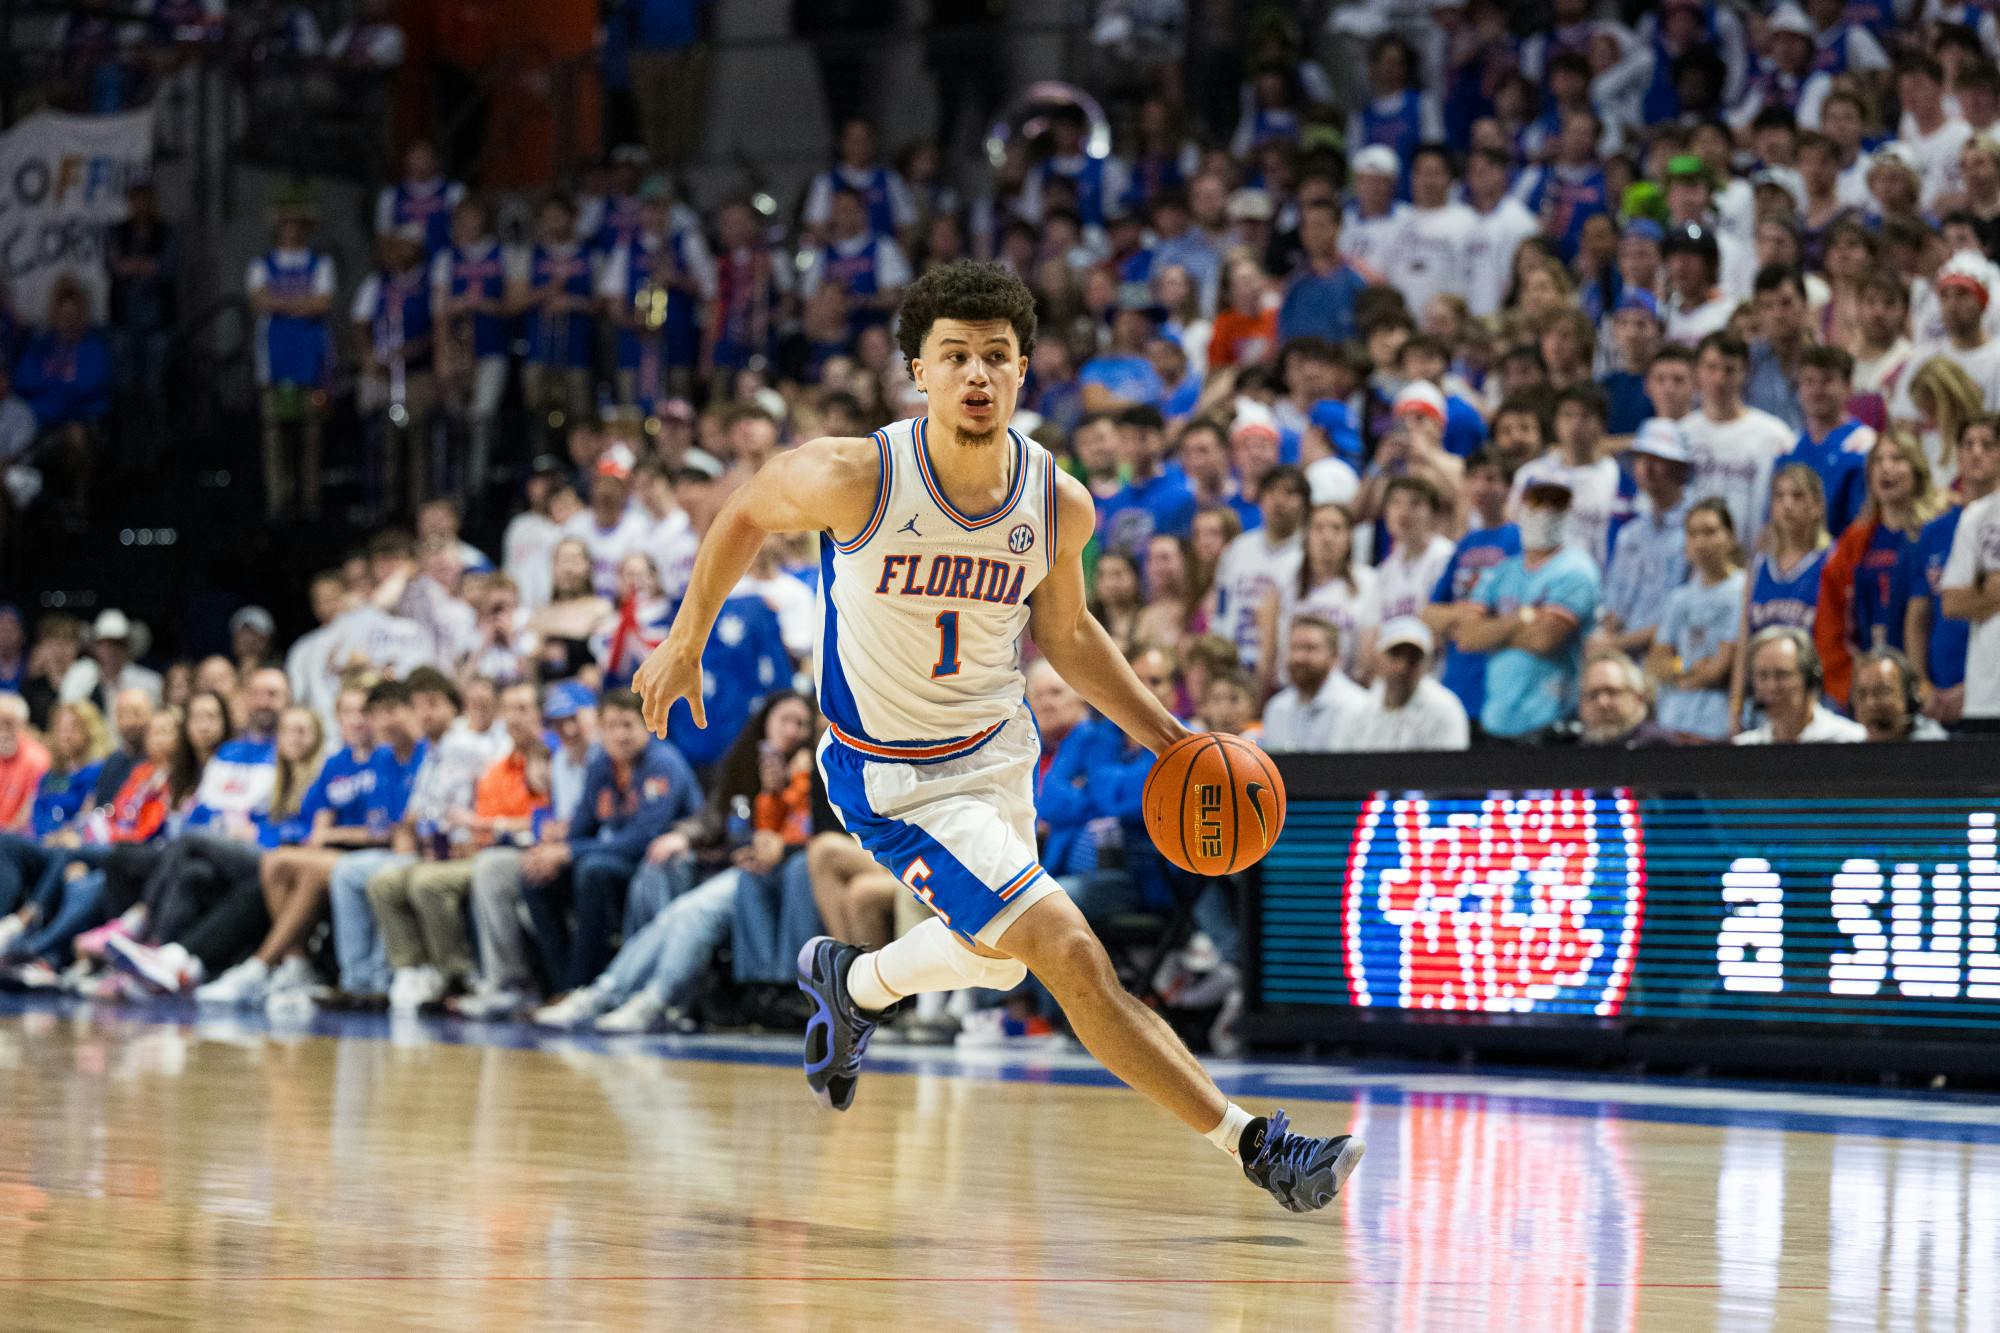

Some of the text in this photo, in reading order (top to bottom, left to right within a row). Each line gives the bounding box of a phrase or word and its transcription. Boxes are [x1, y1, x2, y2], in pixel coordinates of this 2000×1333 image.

[1009, 525, 1033, 553] SEC
[875, 555, 1025, 605] FLORIDA
[931, 610, 961, 678] 1
[1201, 784, 1222, 858] ELITE
[1716, 858, 1784, 992] a
